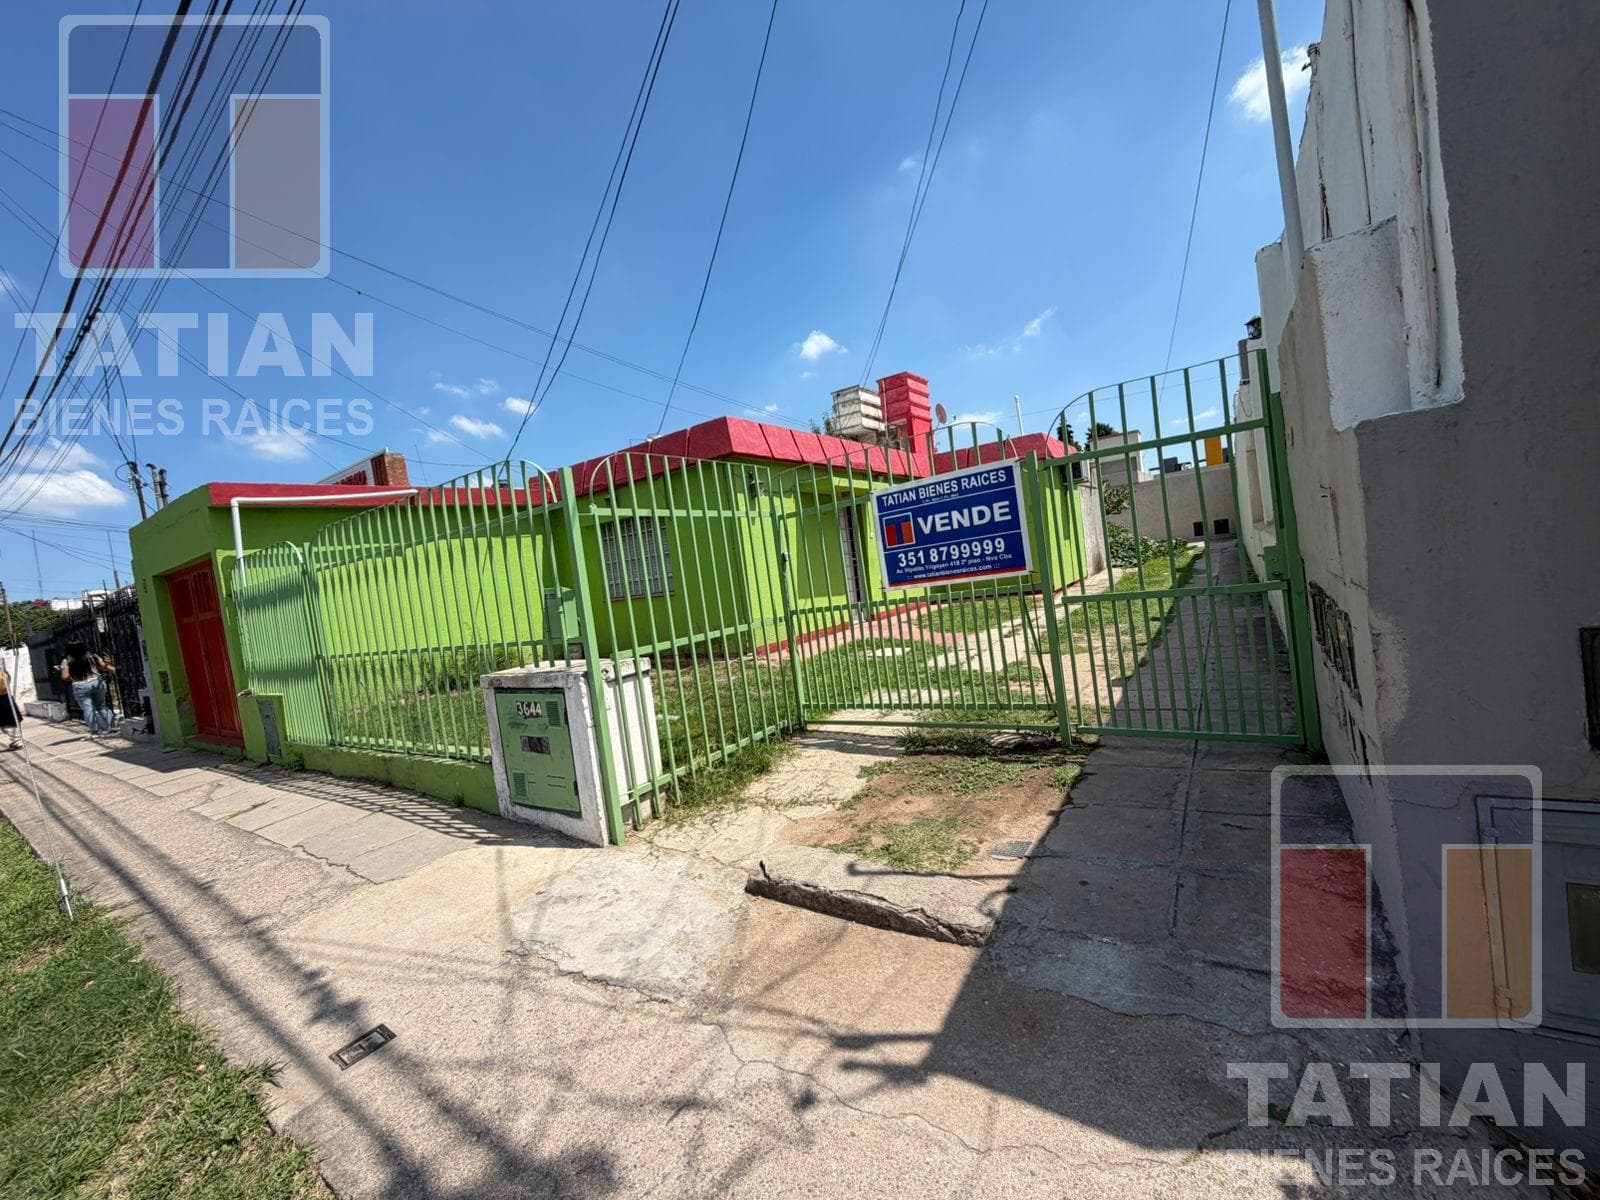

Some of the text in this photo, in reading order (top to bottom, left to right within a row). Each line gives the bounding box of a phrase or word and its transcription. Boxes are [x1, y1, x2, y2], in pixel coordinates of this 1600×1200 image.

[882, 490, 916, 507] TATIAN
[919, 480, 958, 499] BIENES
[961, 470, 1006, 490] RAICES
[917, 501, 1012, 534] VENDE
[898, 538, 1005, 567] 351 8799999
[517, 701, 542, 717] 3644
